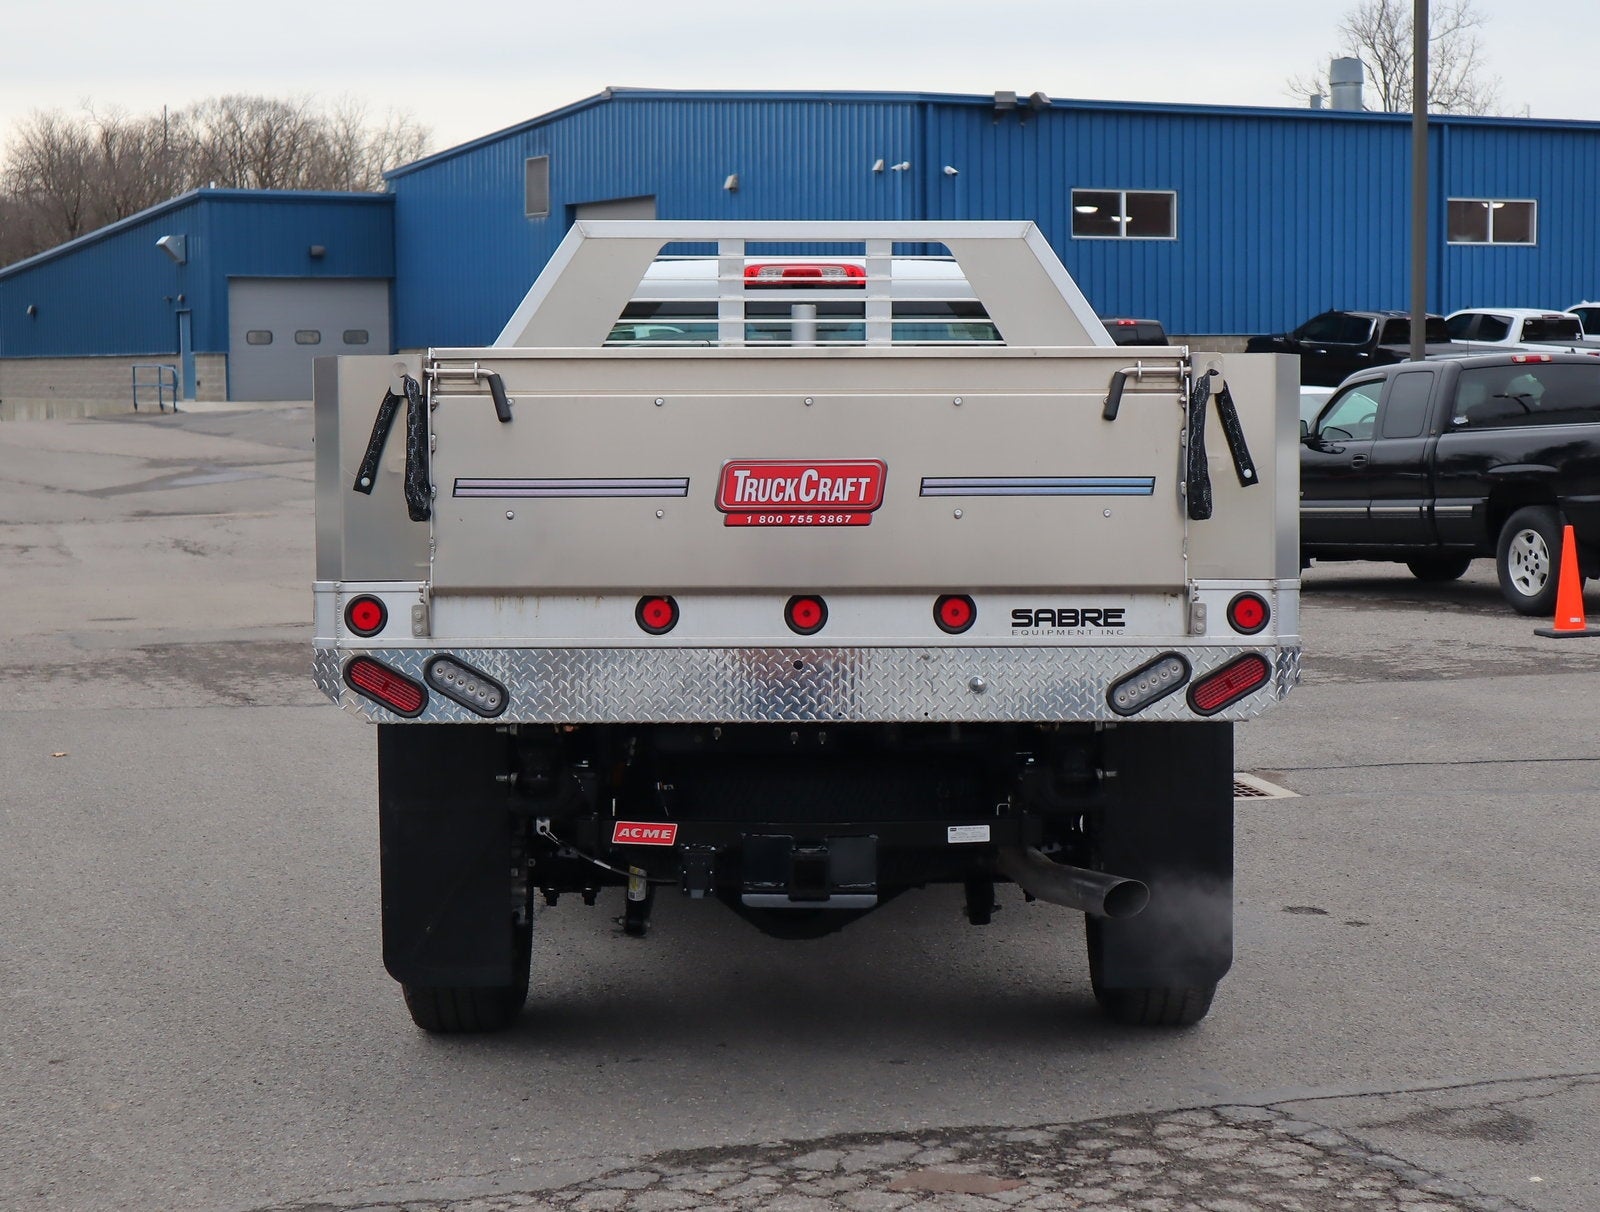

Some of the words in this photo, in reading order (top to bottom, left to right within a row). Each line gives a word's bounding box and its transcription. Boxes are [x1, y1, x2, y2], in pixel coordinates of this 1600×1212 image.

[746, 515, 752, 524] 1
[758, 515, 784, 524] 800
[790, 515, 814, 524] 755
[819, 514, 852, 524] 3867
[1011, 608, 1126, 627] SABRE
[618, 828, 672, 839] ACME
